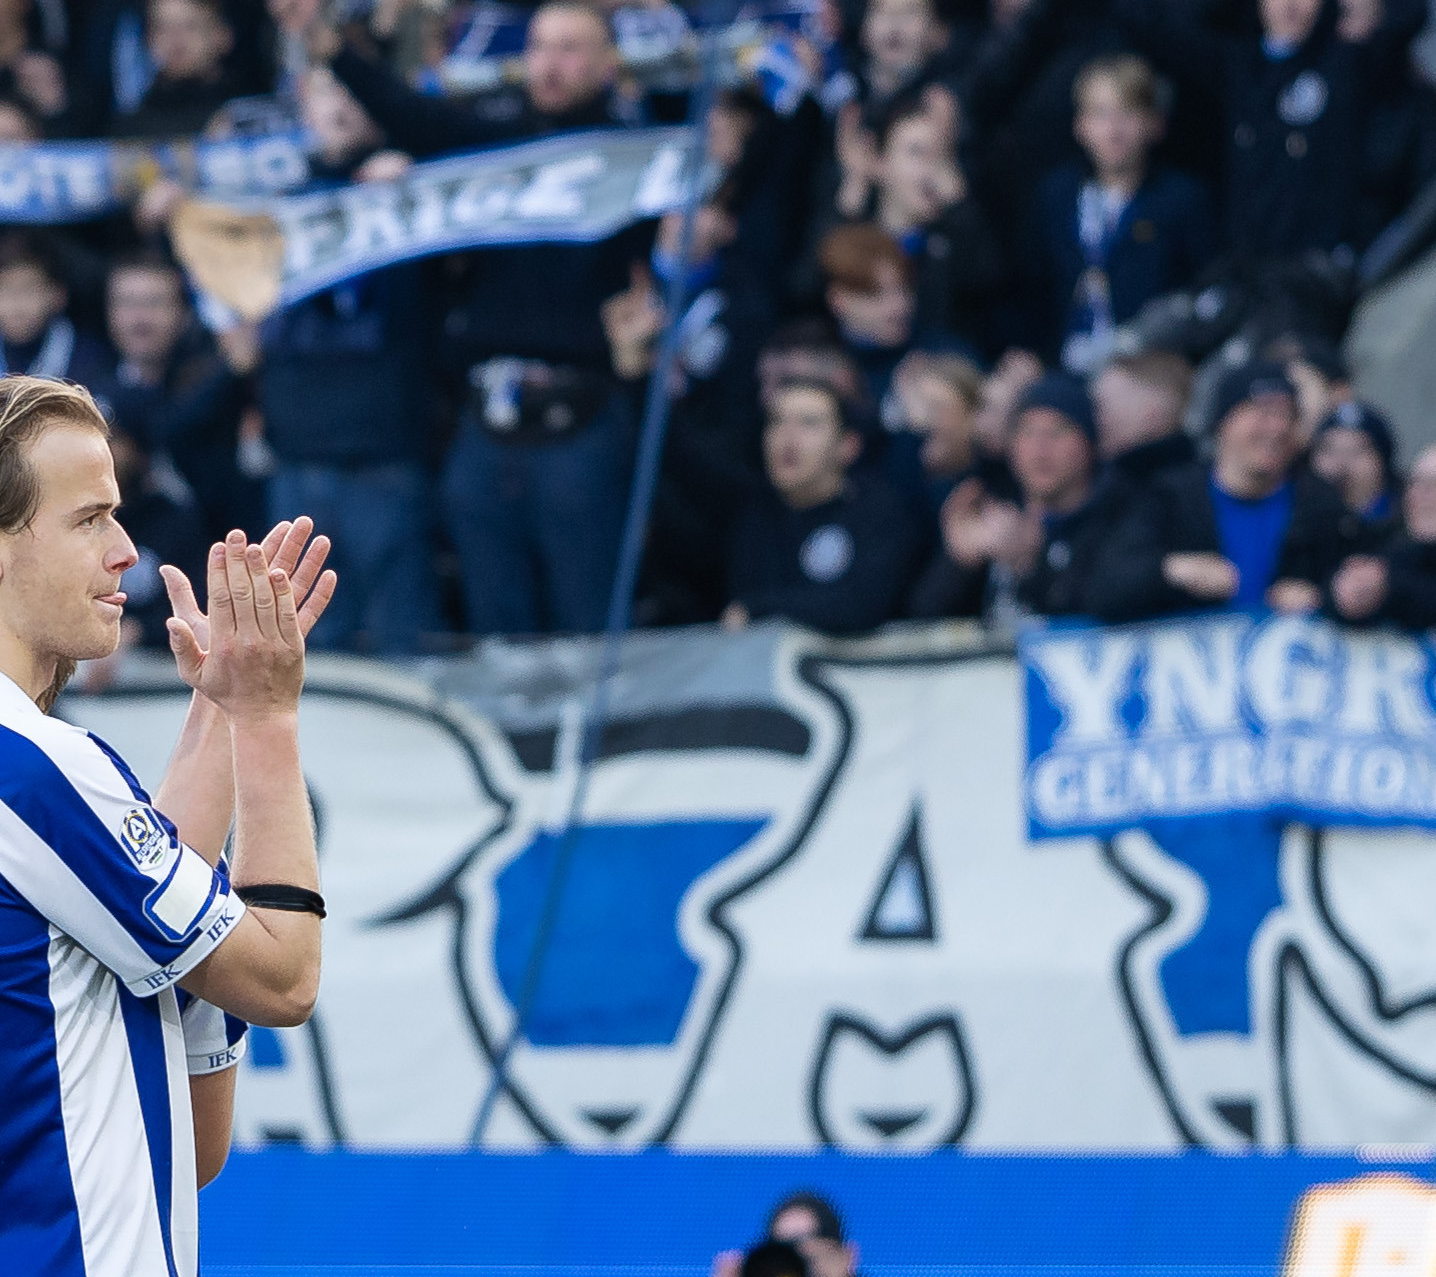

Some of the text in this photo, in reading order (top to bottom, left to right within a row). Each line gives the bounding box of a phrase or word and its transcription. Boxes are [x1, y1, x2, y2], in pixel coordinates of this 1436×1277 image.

[206, 909, 235, 943] IFK
[144, 964, 183, 990] IFK
[208, 1046, 238, 1070] IFK
